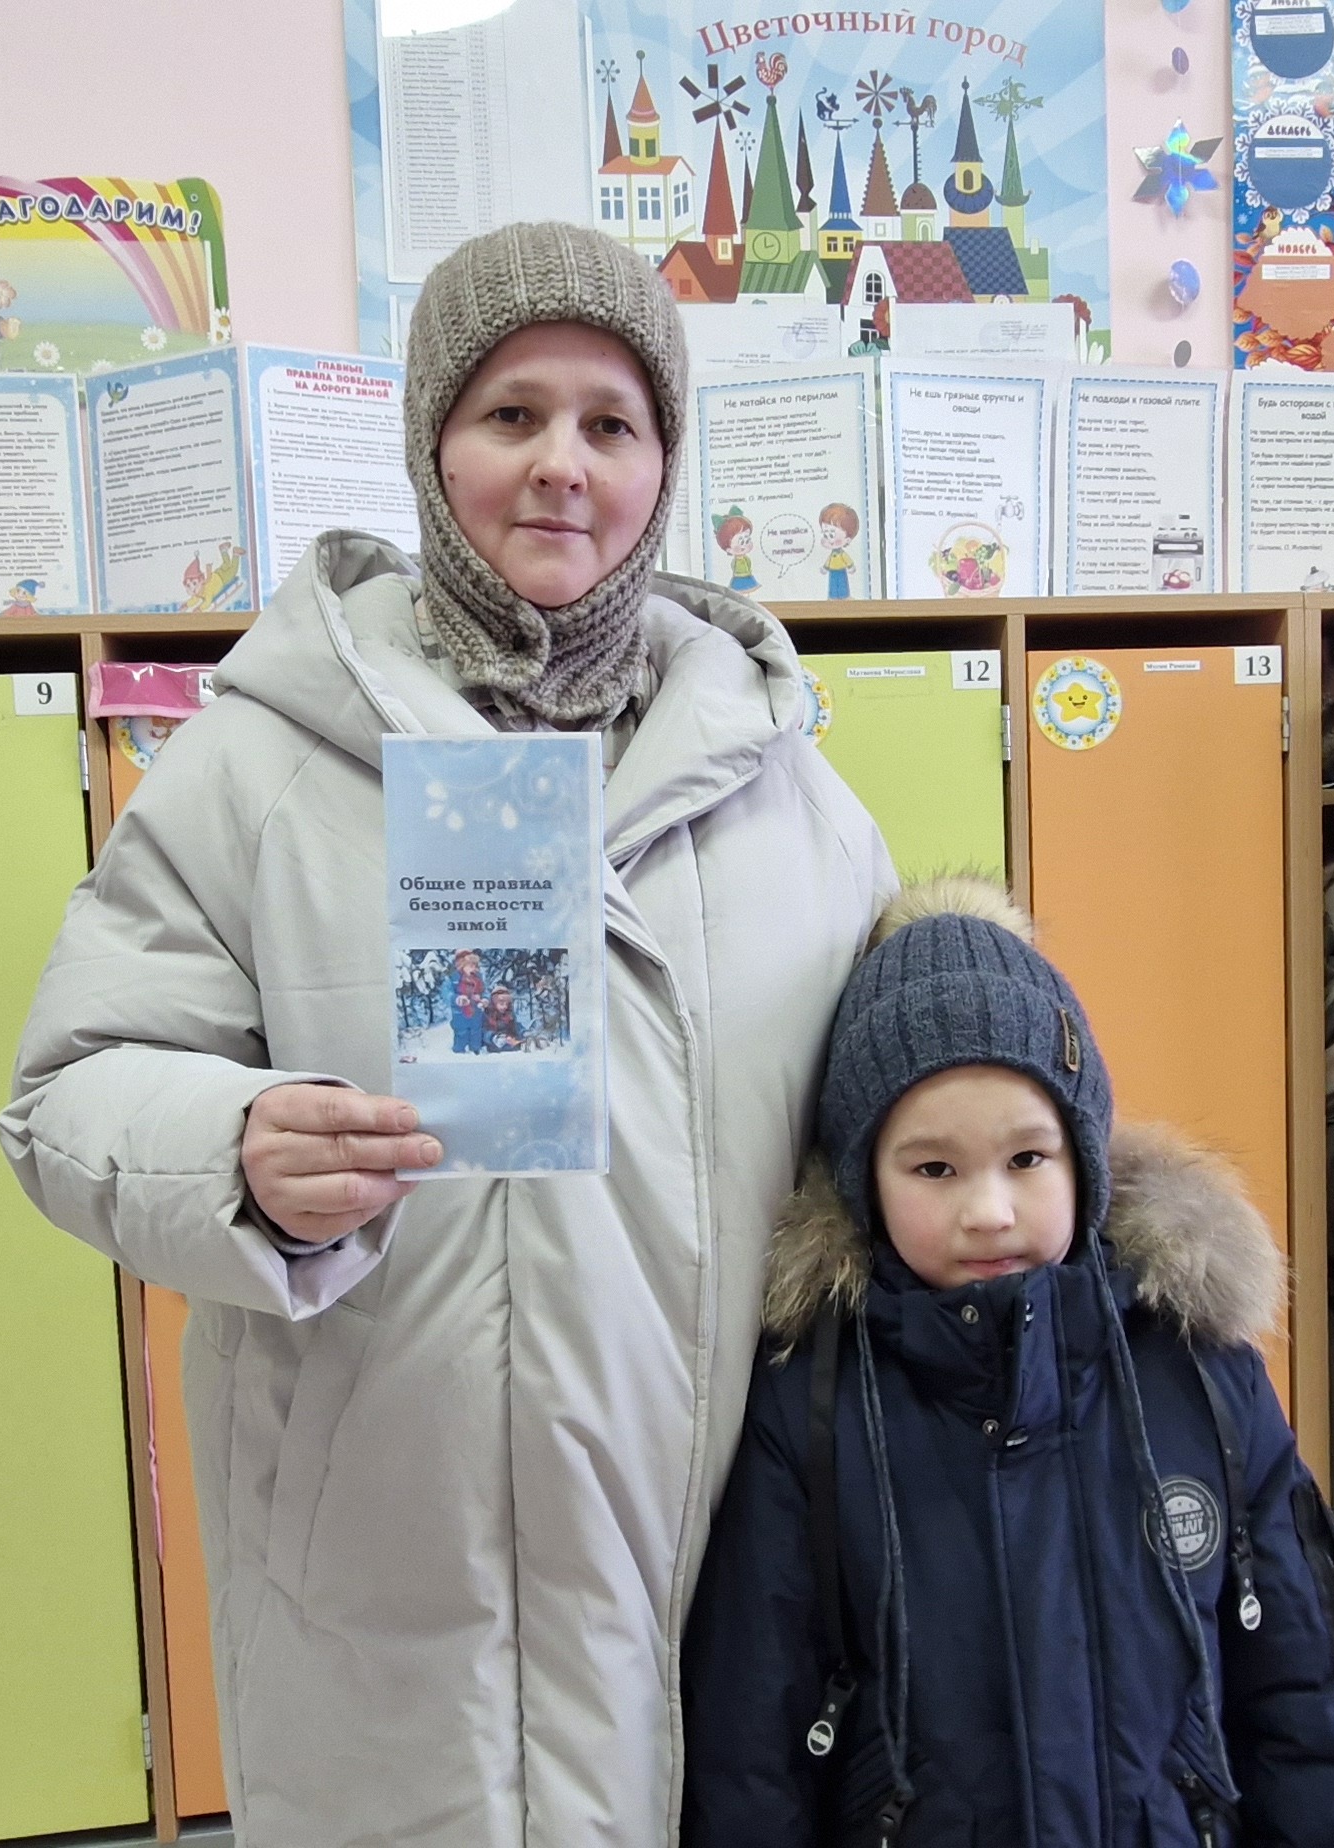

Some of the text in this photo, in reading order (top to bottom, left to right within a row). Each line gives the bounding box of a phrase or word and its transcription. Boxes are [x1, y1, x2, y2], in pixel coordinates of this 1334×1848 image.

[696, 8, 1030, 68] Цветочный город
[1267, 125, 1311, 136] ДЕКАБРЬ
[1278, 244, 1317, 254] НОЯБРЬ
[317, 361, 363, 374] ГЛАВНЫЕ
[286, 369, 394, 388] ПРАВИЛА ПОВЕДЕНИЯ
[295, 381, 389, 399] НА ДОРОГЕ ЗИМОЙ
[910, 388, 922, 398] Не
[924, 390, 941, 399] ешь
[944, 391, 979, 402] грязные
[982, 393, 1015, 404] фрукты
[723, 391, 838, 409] Не катайся по перилам
[1078, 393, 1089, 403] Не
[1092, 394, 1130, 405] подходи
[1139, 396, 1172, 405] газовой
[1174, 399, 1201, 407] плите
[1258, 397, 1277, 409] Будь
[1279, 399, 1324, 409] осторожен
[952, 405, 981, 414] овощи
[1301, 411, 1327, 420] водой
[779, 527, 808, 535] катайся
[772, 548, 805, 557] перилам
[963, 660, 991, 682] 12
[1245, 655, 1271, 676] 13
[36, 681, 53, 704] 9
[399, 876, 553, 894] Общие правила
[409, 897, 544, 911] безопасности
[447, 917, 508, 931] зимой
